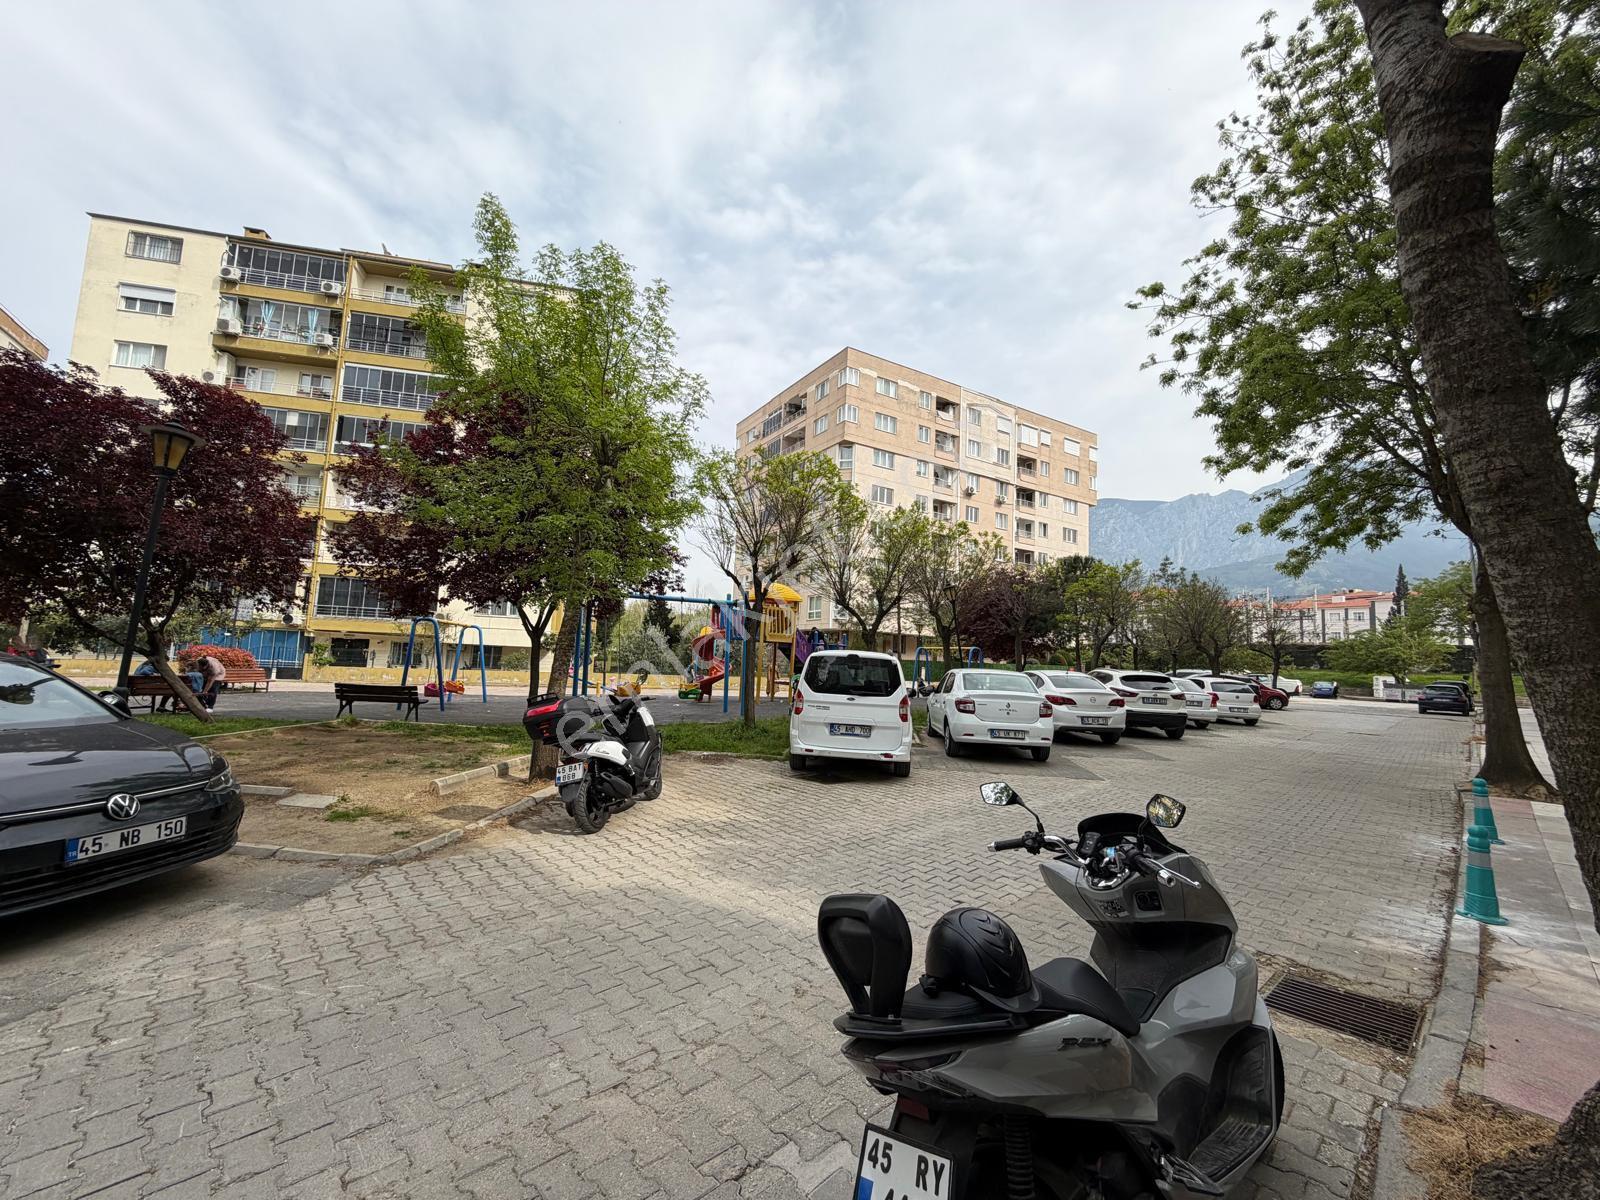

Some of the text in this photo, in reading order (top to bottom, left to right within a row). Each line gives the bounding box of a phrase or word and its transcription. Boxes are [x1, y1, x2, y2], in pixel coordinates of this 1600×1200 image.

[79, 819, 183, 856] 45 NB 150
[867, 1138, 945, 1197] 45 RY
